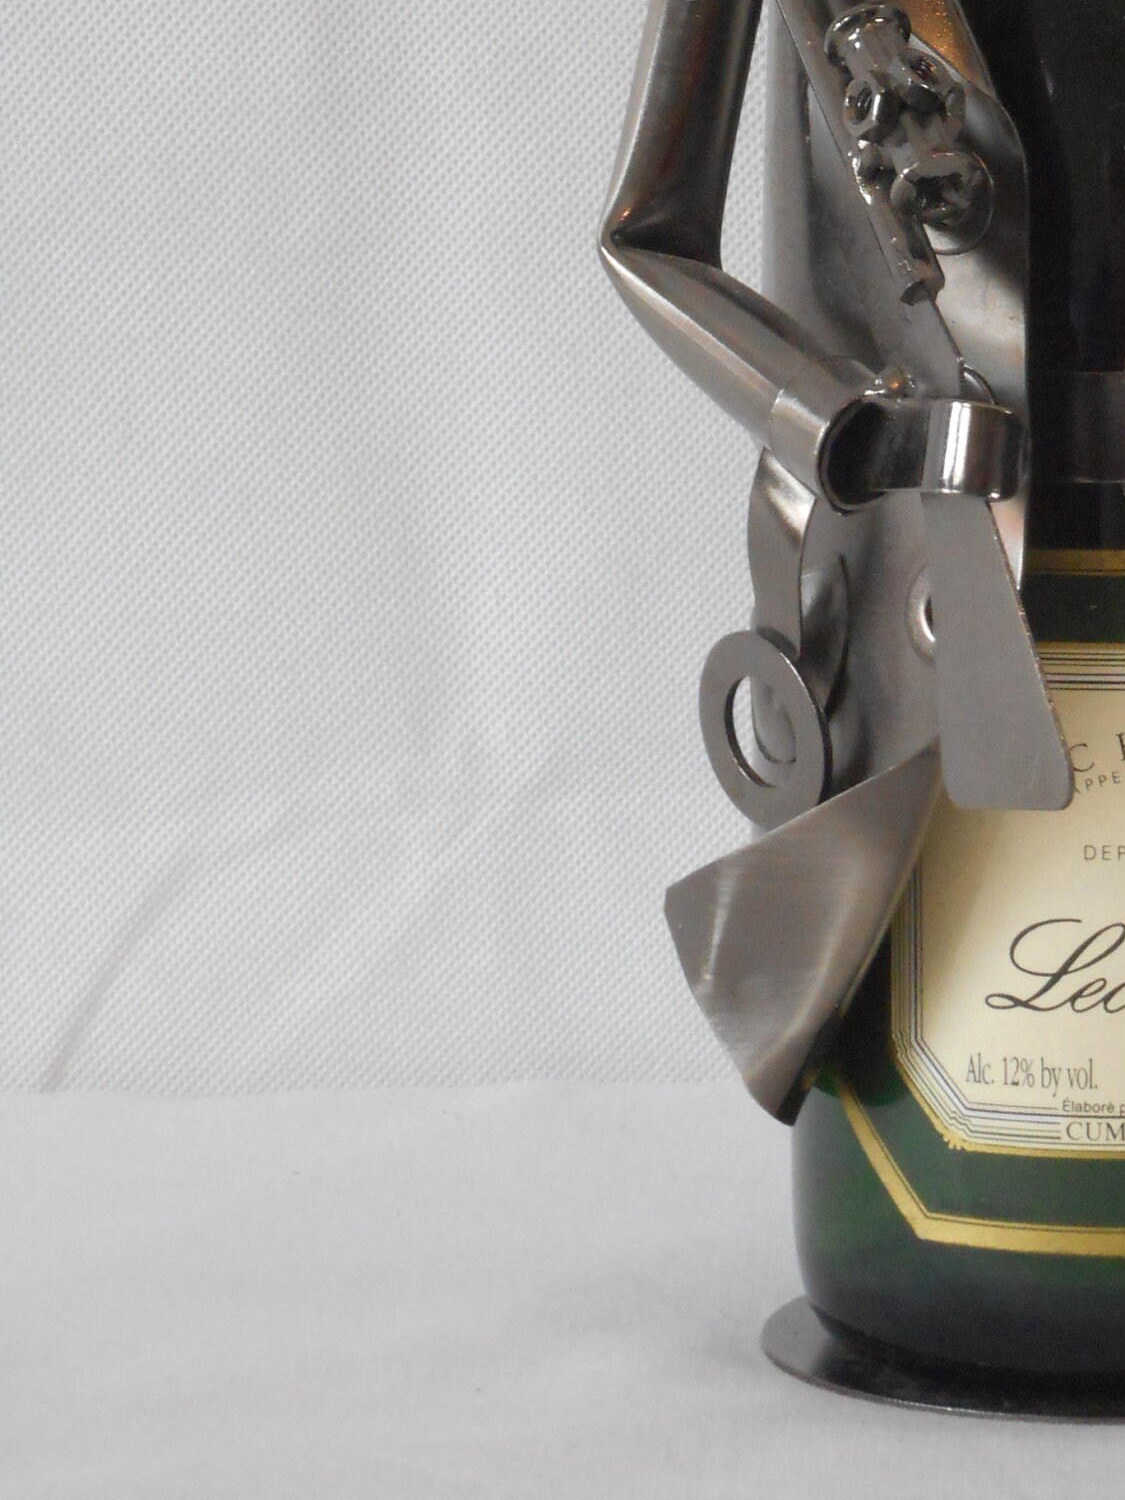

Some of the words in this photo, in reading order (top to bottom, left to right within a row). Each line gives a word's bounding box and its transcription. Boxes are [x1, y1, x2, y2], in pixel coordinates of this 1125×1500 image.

[966, 1051, 995, 1085] Alc.
[1002, 1056, 1035, 1088] 12%
[1040, 1056, 1061, 1098] by
[1067, 1057, 1098, 1090] vol.
[1062, 1097, 1115, 1114] Élaboré
